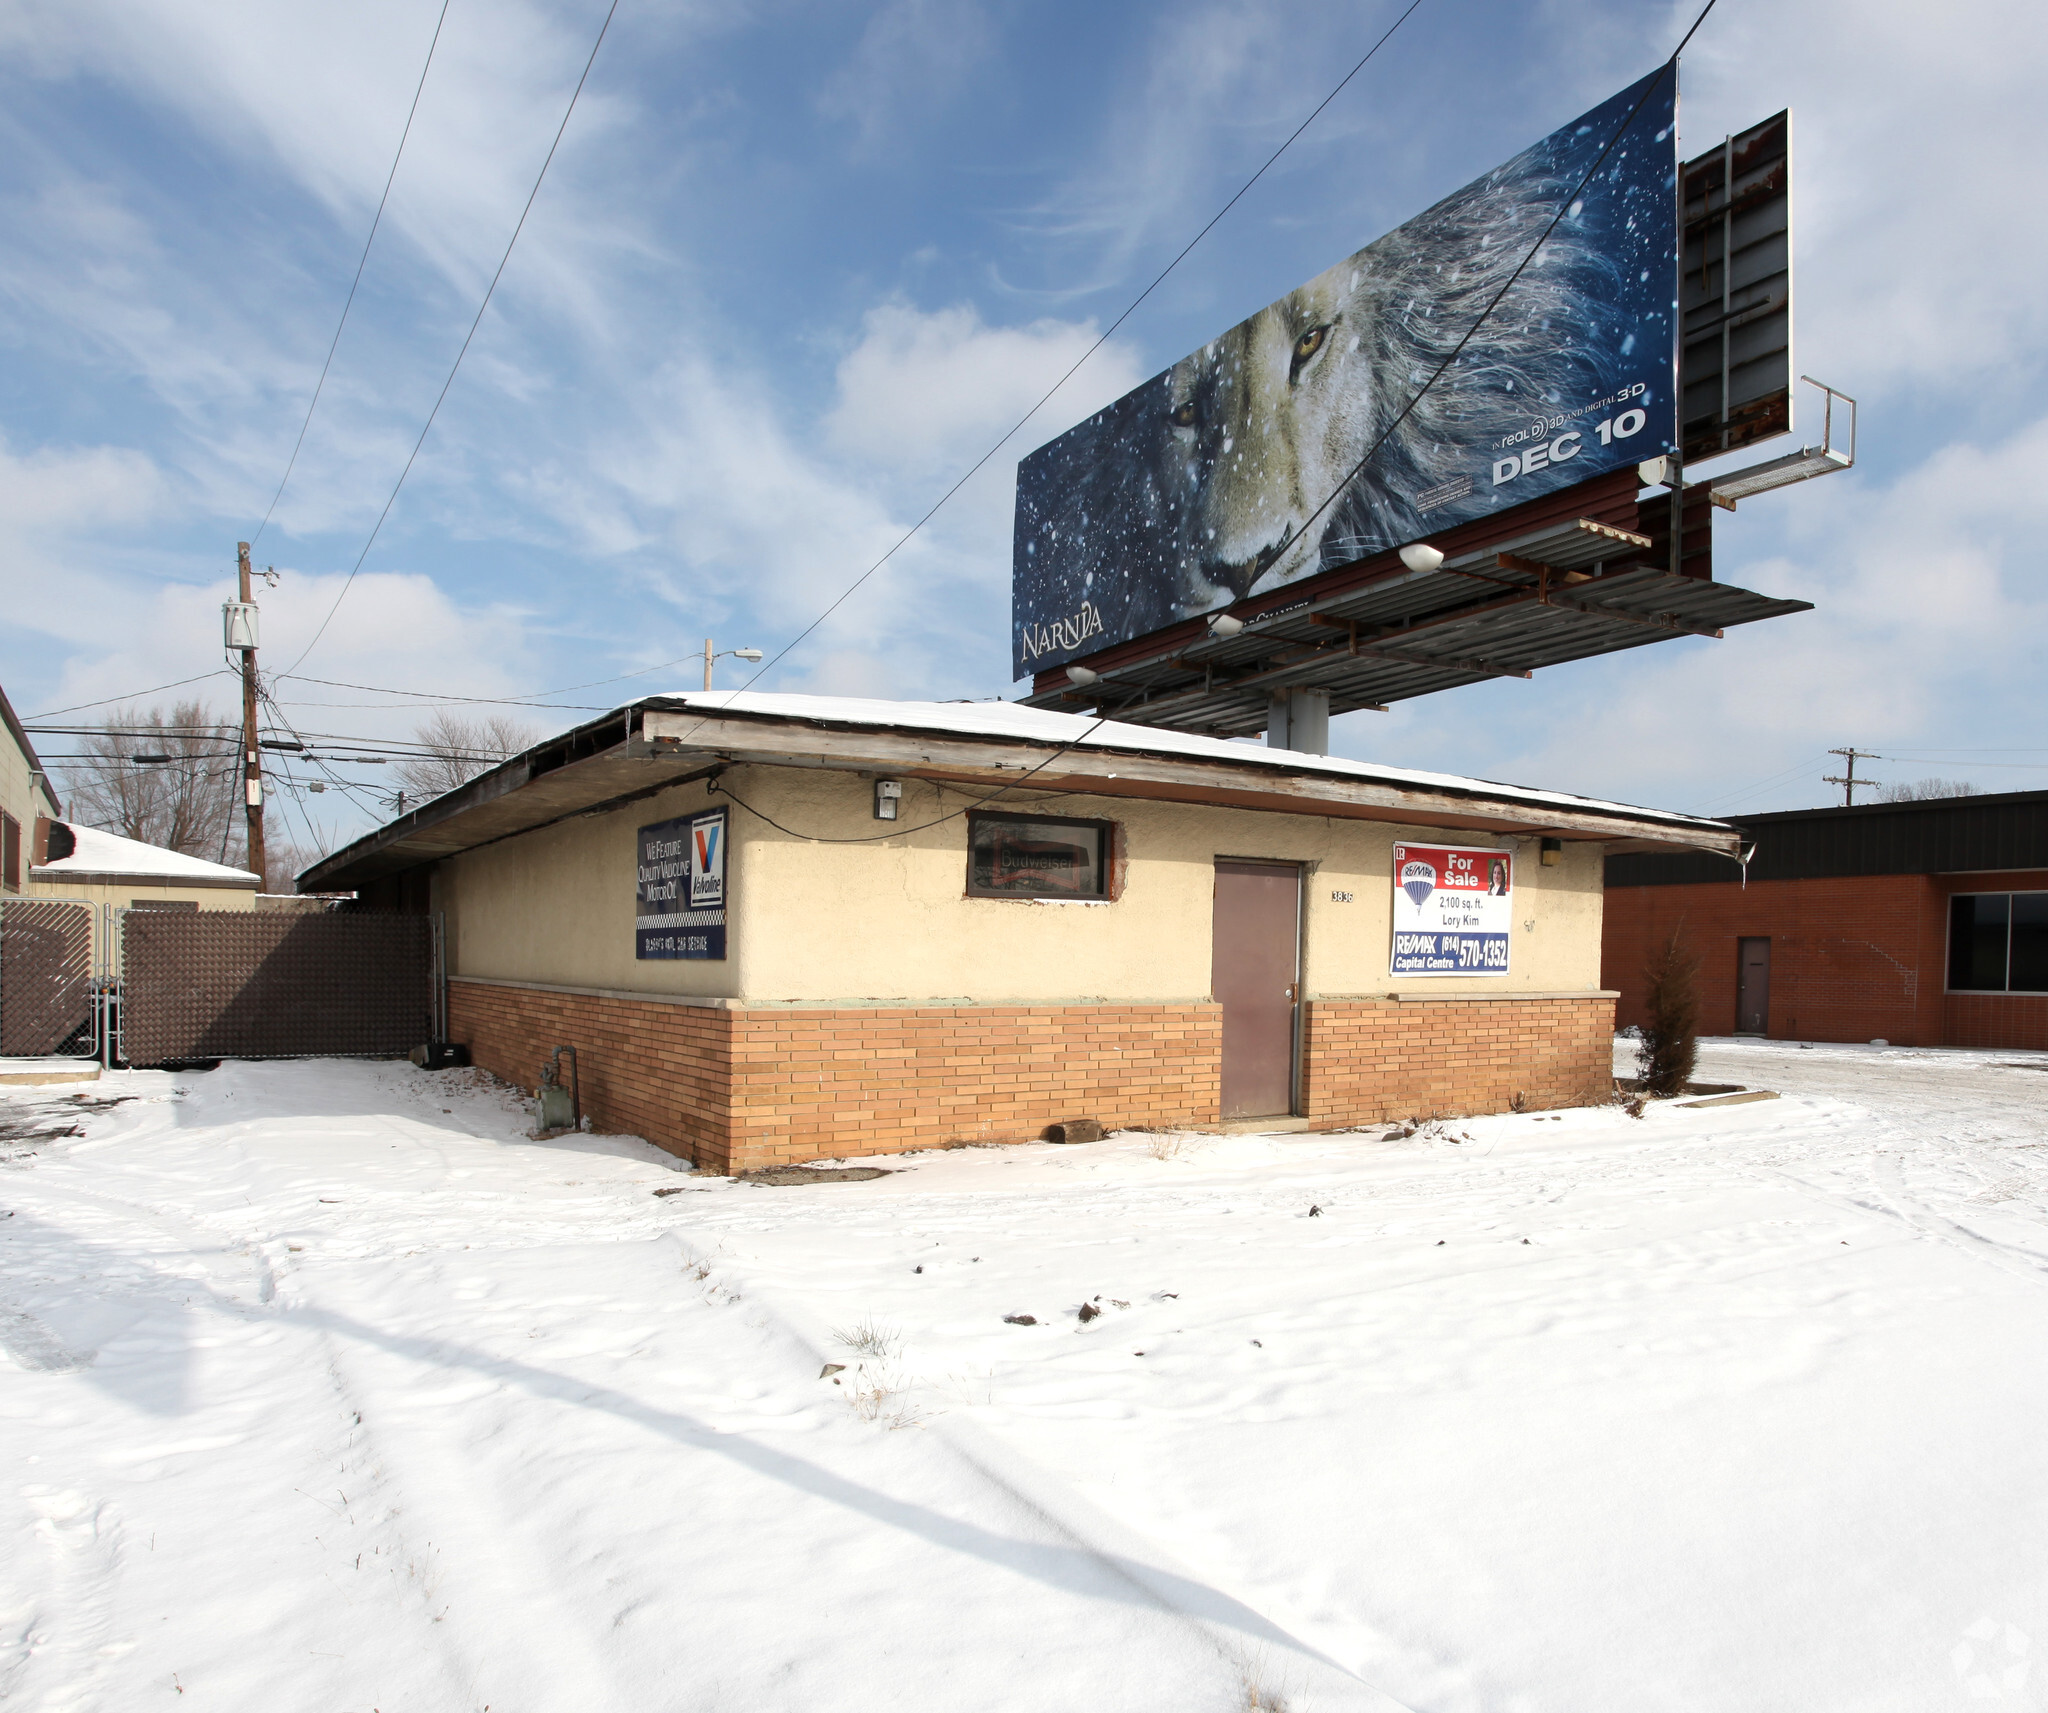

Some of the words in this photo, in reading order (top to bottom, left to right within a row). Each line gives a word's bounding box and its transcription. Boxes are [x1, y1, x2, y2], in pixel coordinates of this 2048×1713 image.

[1550, 415, 1565, 430] 3D
[1566, 408, 1583, 422] AND
[1585, 395, 1616, 414] DIGITAL
[1493, 431, 1582, 487] DEC
[1595, 408, 1646, 446] 10
[1021, 601, 1104, 663] NARNIA
[656, 840, 681, 859] FEATURE
[1002, 850, 1073, 870] Budweiser
[1447, 854, 1473, 870] For
[638, 865, 661, 883] QUALITY
[661, 860, 690, 879] VALVOLINE
[1444, 871, 1478, 887] Sale
[647, 884, 667, 902] MOTOR
[667, 880, 677, 900] OIL
[693, 876, 721, 895] Valvoline
[1332, 891, 1353, 903] 3836
[1440, 896, 1460, 909] 2,100
[1462, 899, 1473, 911] sq.
[1474, 897, 1483, 909] ft.
[1442, 914, 1461, 928] Lory
[1463, 914, 1479, 926] Kim
[1397, 934, 1437, 954] RE/MAX
[1441, 936, 1460, 955] (614)
[1459, 939, 1507, 967] 570-1352
[1395, 956, 1425, 971] Capital
[1426, 956, 1454, 969] Centre
